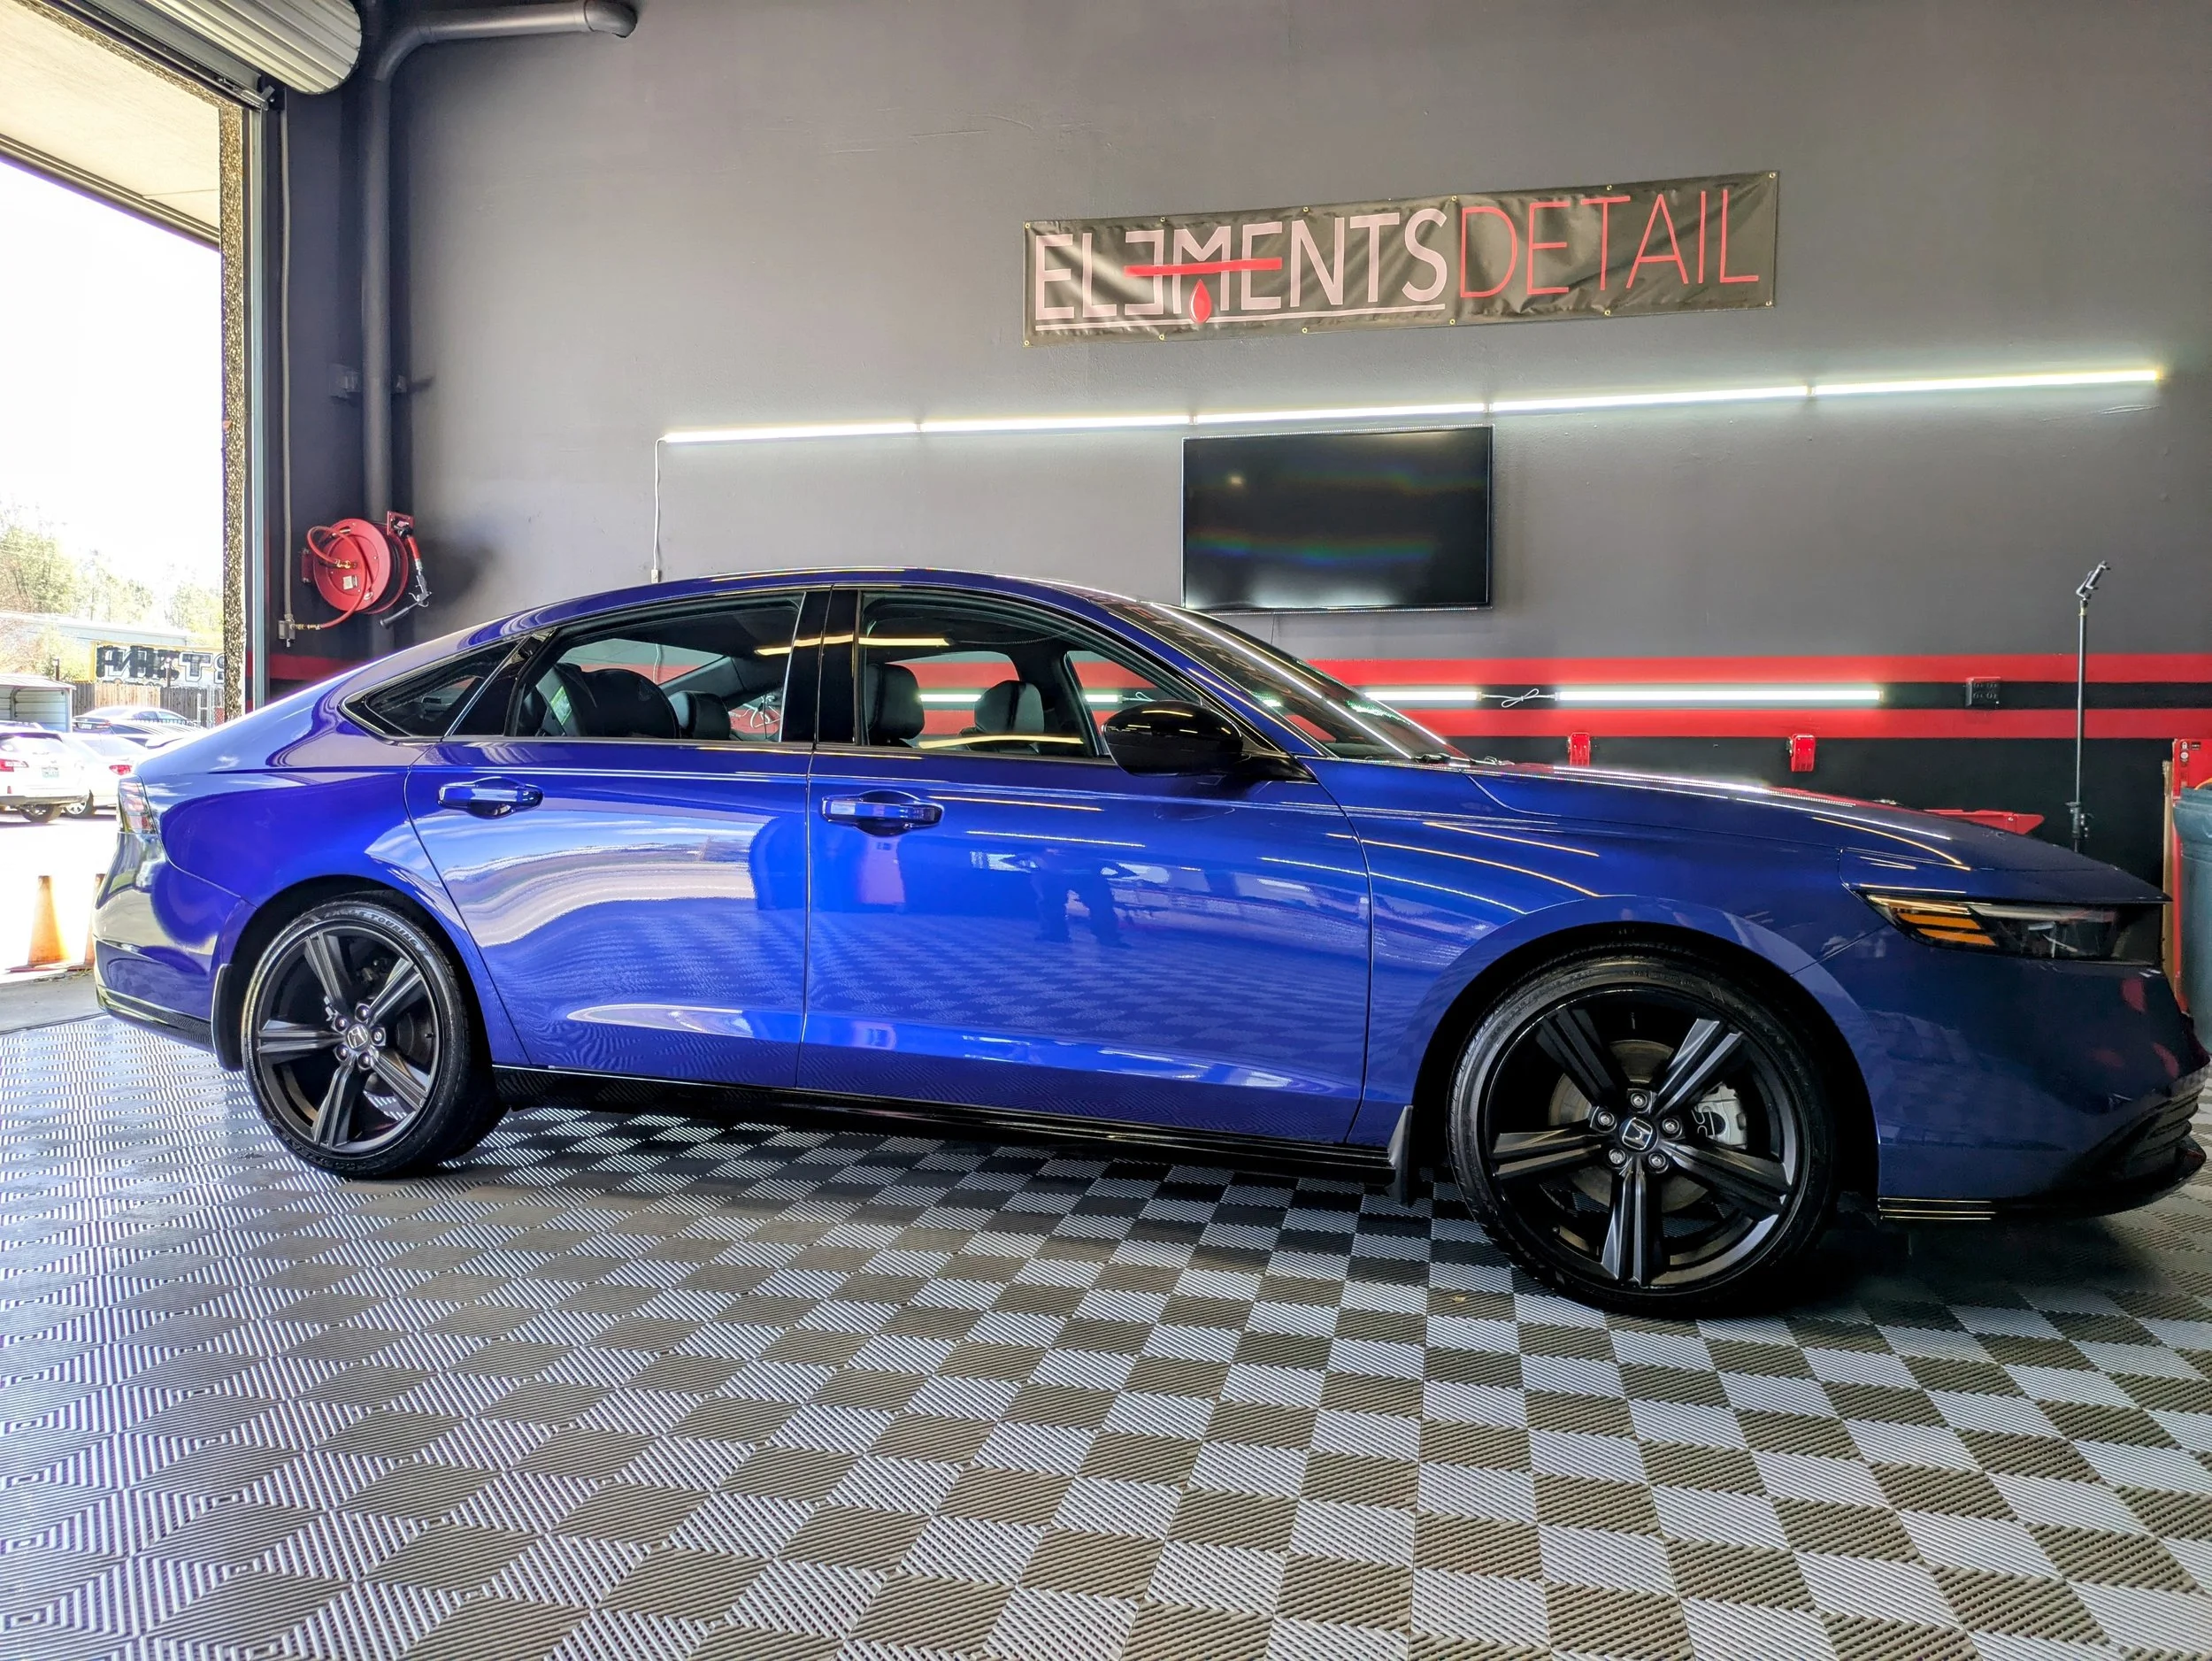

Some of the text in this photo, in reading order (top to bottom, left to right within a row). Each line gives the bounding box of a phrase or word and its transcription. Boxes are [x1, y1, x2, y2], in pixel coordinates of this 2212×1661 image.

[1035, 189, 1759, 319] ELEMENTS DETAIL
[371, 913, 419, 947] TOURING
